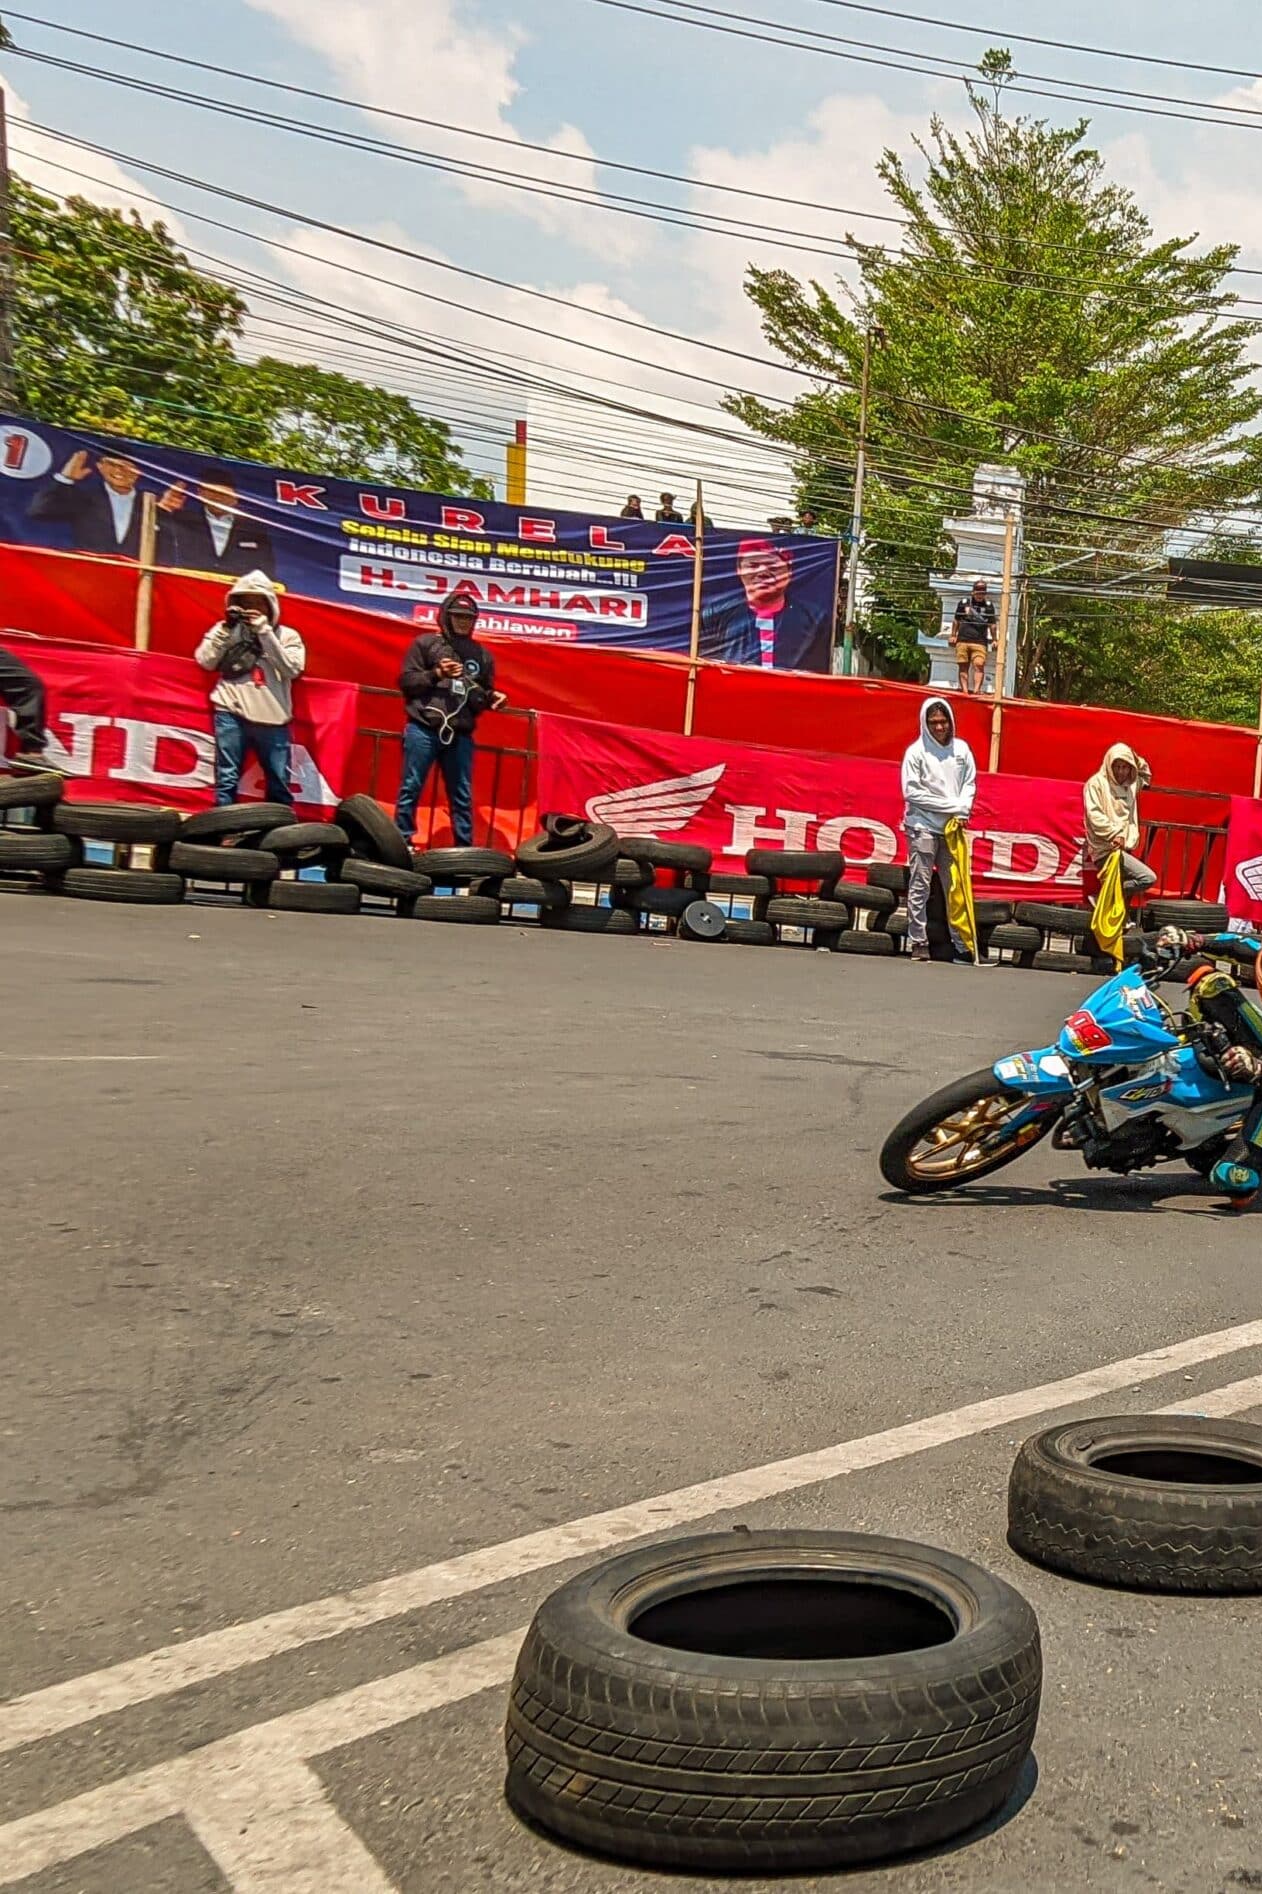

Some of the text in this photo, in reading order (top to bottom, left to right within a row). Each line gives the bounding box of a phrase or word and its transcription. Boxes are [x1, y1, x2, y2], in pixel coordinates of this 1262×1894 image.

[2, 434, 29, 470] 1
[340, 520, 428, 545] Selalu
[497, 542, 646, 573] Mendukung
[349, 538, 484, 570] Indonesia
[360, 566, 642, 619] H. JAMHARI
[475, 616, 572, 638] ahlawan
[722, 804, 1084, 886] HOD
